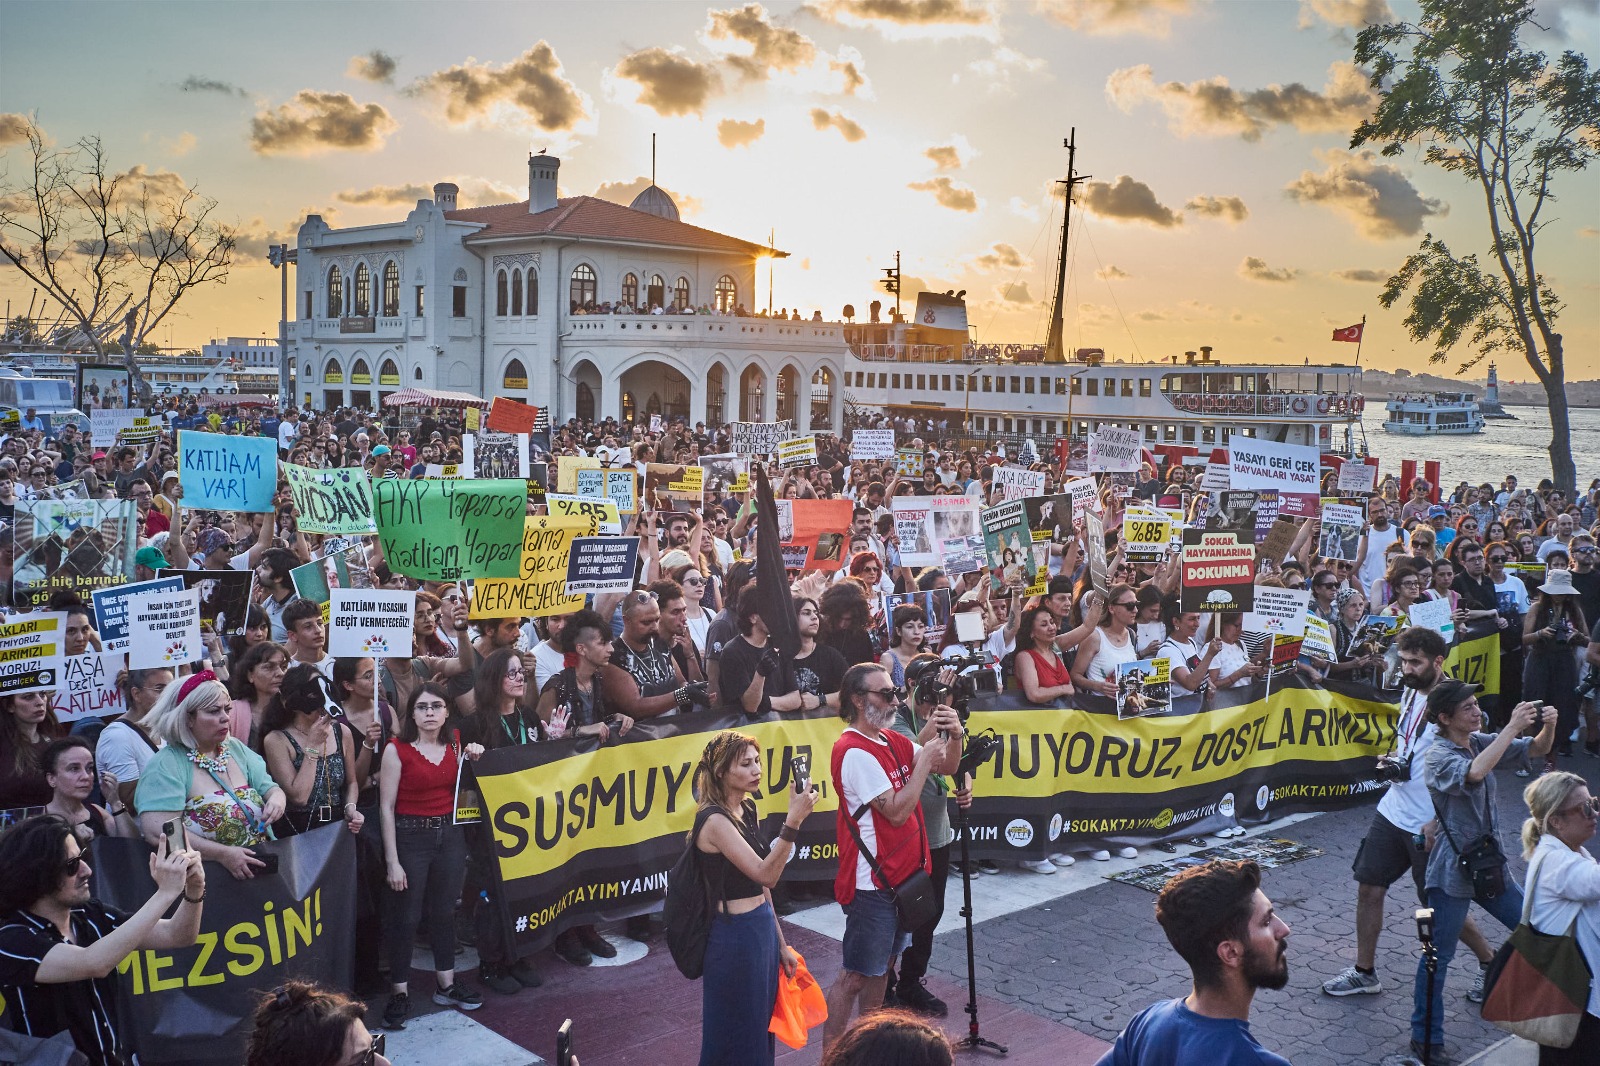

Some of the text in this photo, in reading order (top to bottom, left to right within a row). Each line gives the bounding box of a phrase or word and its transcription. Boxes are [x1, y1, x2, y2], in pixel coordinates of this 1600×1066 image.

[135, 418, 147, 426] BİZ
[185, 448, 261, 479] KATLİAM
[444, 466, 457, 475] BİZ
[1233, 451, 1316, 473] YASAYI GERİ ÇEK
[1234, 464, 1287, 480] HAYVANLARI
[1290, 473, 1316, 484] YAŞAT
[202, 477, 248, 506] VAR!
[376, 480, 430, 528] AKP
[1131, 521, 1163, 542] %85
[1205, 537, 1235, 546] SOKAK
[384, 537, 459, 568] Katliam
[1186, 548, 1252, 558] HAYVANLARINA
[51, 575, 73, 589] hiç
[76, 573, 128, 586] barınak
[1187, 564, 1250, 580] DOKUNMA
[340, 599, 408, 613] KATLİAM YASASINA
[335, 614, 410, 630] GEÇİT VERMEYECEĞİZ!
[1, 646, 43, 661] ARIMIZI
[64, 655, 105, 681] YASA
[50, 687, 122, 714] KATLİAM
[515, 869, 670, 933] #SOKAKTAYIMYANIN
